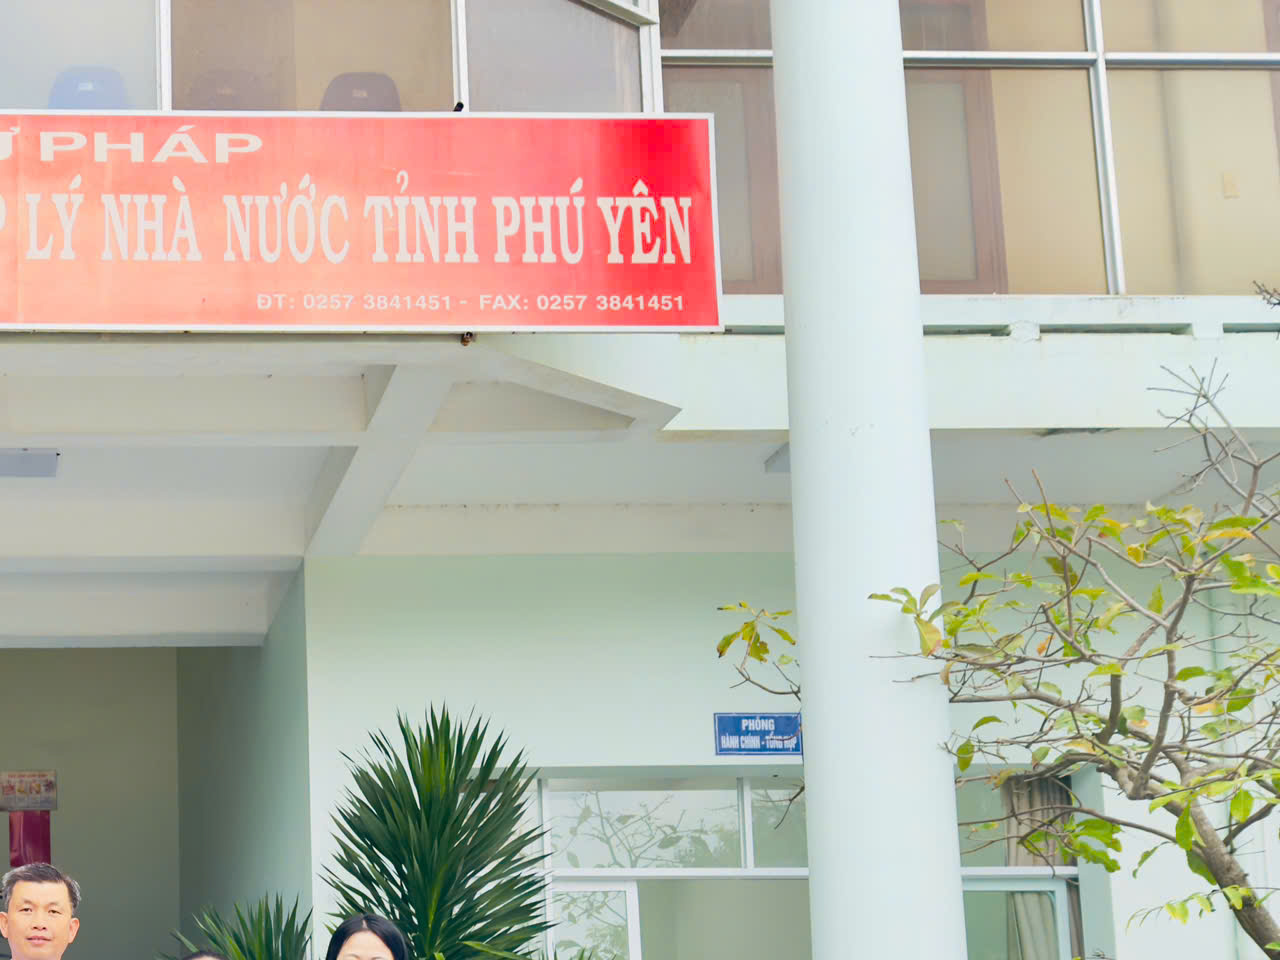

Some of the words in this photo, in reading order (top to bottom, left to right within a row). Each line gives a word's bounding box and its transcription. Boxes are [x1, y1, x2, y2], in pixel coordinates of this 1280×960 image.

[40, 125, 263, 163] PHÁP
[25, 173, 85, 261] LÝ
[101, 175, 203, 262] NHÀ
[222, 172, 350, 264] NƯỚC
[363, 170, 479, 263] TỈNH
[491, 177, 586, 264] PHÚ
[596, 178, 693, 264] YÊN
[256, 293, 295, 310] ĐT:
[303, 293, 355, 310] 0257
[363, 294, 452, 310] 3841451
[479, 293, 529, 310] FAX:
[536, 294, 588, 311] 0257
[596, 294, 685, 311] 3841451
[741, 716, 775, 731] PHÒNG
